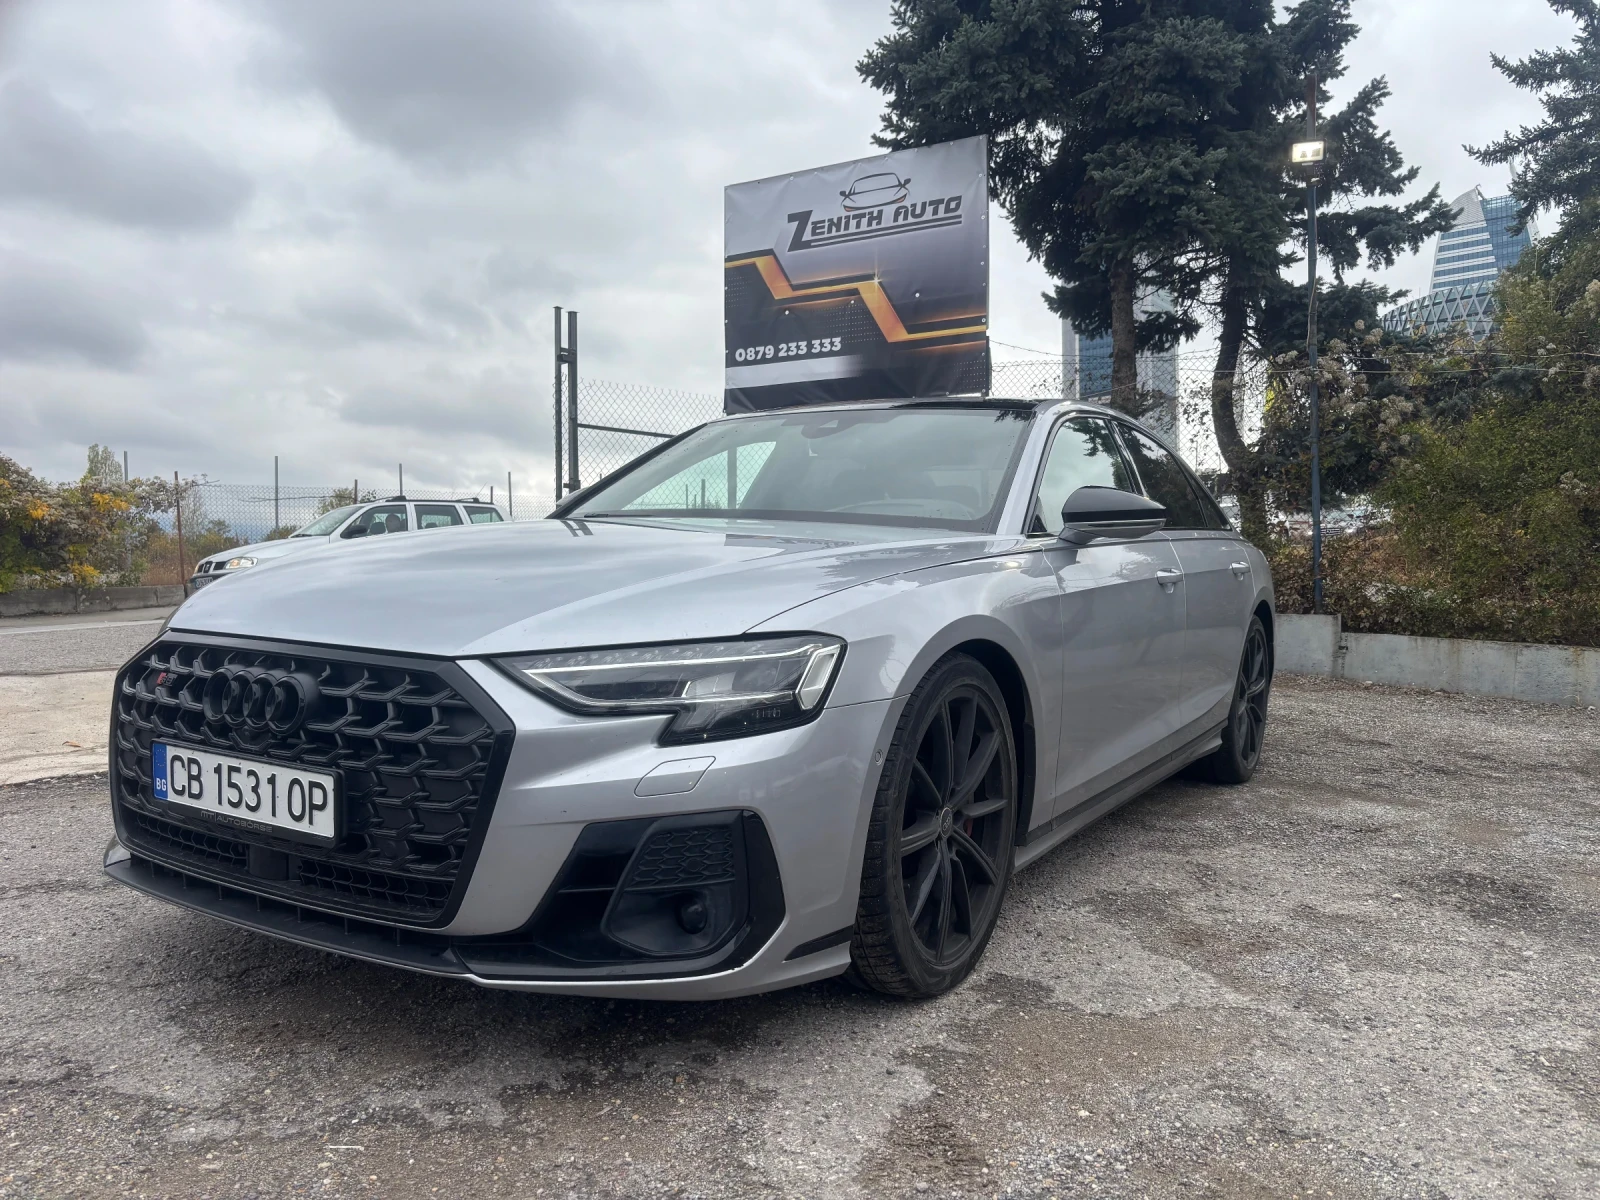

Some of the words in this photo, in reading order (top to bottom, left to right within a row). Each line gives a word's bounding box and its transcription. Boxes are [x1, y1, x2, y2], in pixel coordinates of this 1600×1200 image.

[787, 209, 883, 252] ZENITH
[892, 195, 963, 223] AUTO
[735, 344, 774, 362] 0879
[778, 341, 807, 357] 233
[811, 337, 842, 355] 333
[156, 777, 167, 791] BG
[170, 754, 204, 799] CB
[213, 762, 277, 818] 1531
